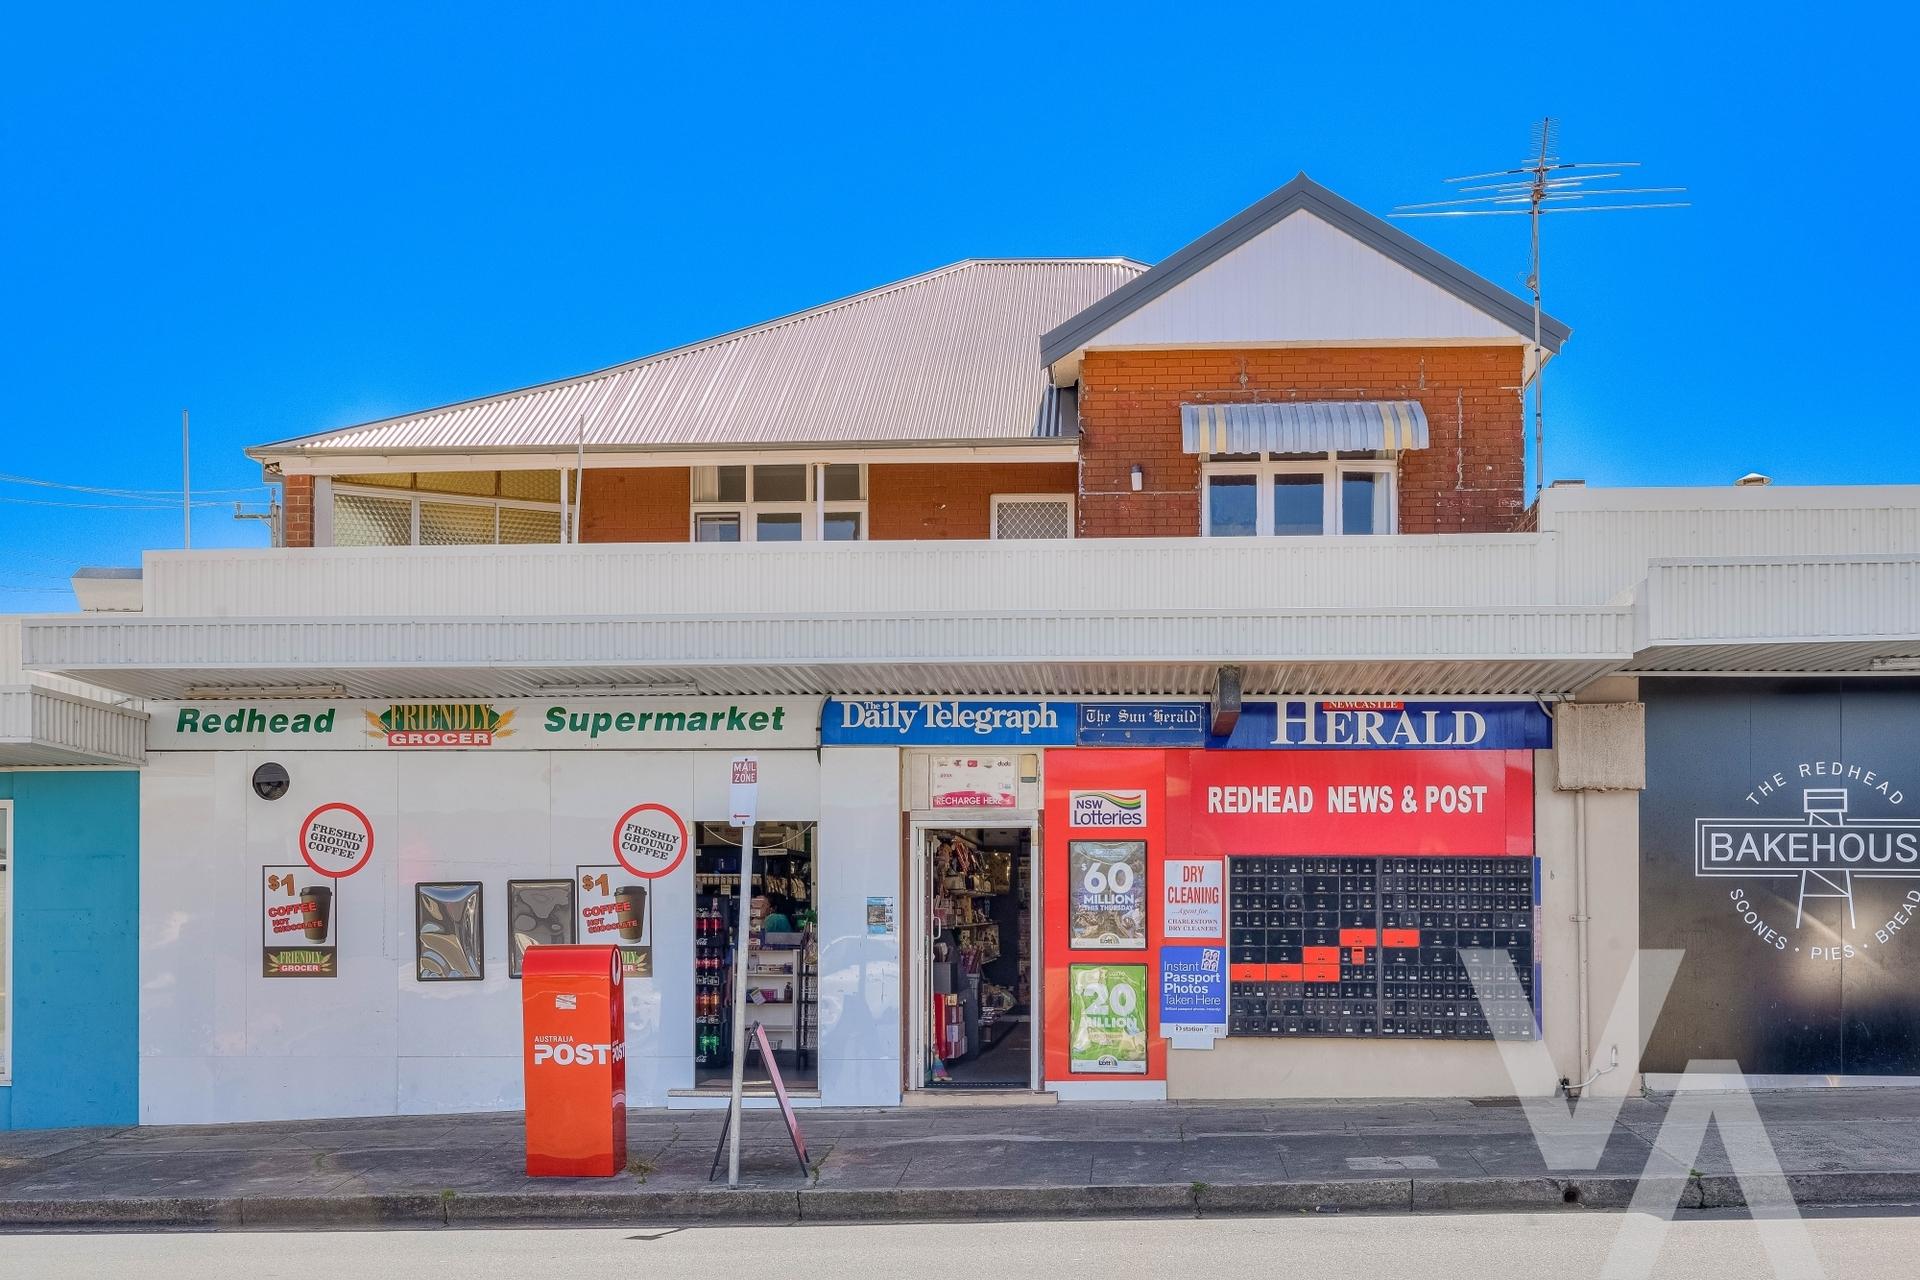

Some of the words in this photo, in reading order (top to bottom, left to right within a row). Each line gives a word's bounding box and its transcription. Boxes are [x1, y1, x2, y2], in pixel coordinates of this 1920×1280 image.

[864, 701, 881, 710] The
[1329, 701, 1398, 709] NEWCASTLE
[176, 708, 336, 734] Redhead
[389, 704, 493, 731] FRIENDLY
[544, 706, 785, 738] Supermarket
[841, 701, 918, 733] Daily
[919, 701, 1058, 734] Telegraph
[1086, 709, 1111, 726] The
[1118, 709, 1146, 723] Sun
[1153, 709, 1197, 726] Herald
[1271, 698, 1486, 745] HERALD
[390, 733, 489, 745] GROCER
[733, 761, 757, 772] MAIL
[734, 772, 756, 783] ZONE
[1746, 772, 1787, 806] THE
[1799, 761, 1904, 806] REDHEAD
[936, 796, 981, 805] RECHARGE
[1076, 799, 1103, 810] NSW
[1208, 786, 1314, 814] REDHEAD
[1328, 785, 1395, 814] NEWS
[1401, 785, 1418, 813] &
[1425, 785, 1488, 813] POST
[1073, 810, 1142, 826] Lotteries
[312, 823, 366, 843] FRESHLY
[625, 823, 680, 845] FRESHLY
[308, 841, 356, 860] COFFEE
[310, 833, 360, 851] GROUND
[623, 832, 675, 853] GROUND
[1710, 832, 1918, 863] BAKEHOUS
[621, 841, 669, 861] COFFEE
[1081, 862, 1134, 894] $60
[1183, 865, 1204, 883] DRY
[267, 873, 296, 897] $1
[582, 873, 610, 897] $1
[1083, 894, 1135, 905] MILLION
[1167, 886, 1219, 904] CLEANING
[268, 902, 317, 918] COFFEE
[582, 902, 632, 918] COFFEE
[272, 917, 290, 927] HOT
[1729, 887, 1789, 951] SCONES
[1811, 944, 1856, 961] PIES
[1874, 888, 1920, 945] BREAD
[279, 951, 322, 964] FRIENDLY
[1164, 960, 1199, 972] Instant
[281, 964, 319, 972] GROCER
[1164, 972, 1221, 985] Passport
[1164, 983, 1209, 994] Photos
[1083, 982, 1137, 1017] 20
[1165, 994, 1194, 1005] Taken
[1196, 994, 1221, 1005] Here
[1084, 1016, 1137, 1029] MILLION
[1182, 1025, 1204, 1033] station
[534, 1035, 574, 1043] AUSTRALIA
[534, 1043, 611, 1066] POST
